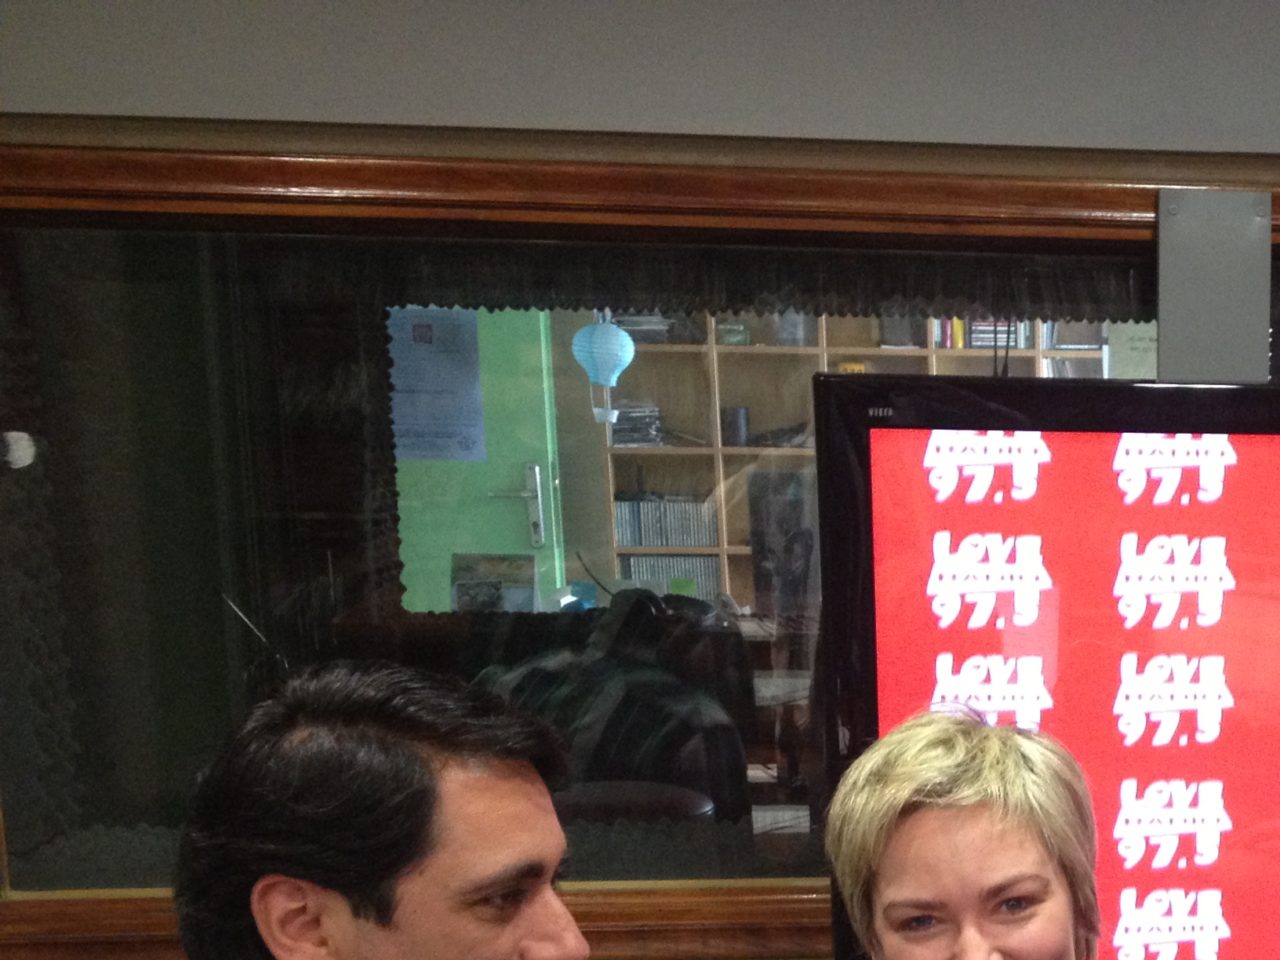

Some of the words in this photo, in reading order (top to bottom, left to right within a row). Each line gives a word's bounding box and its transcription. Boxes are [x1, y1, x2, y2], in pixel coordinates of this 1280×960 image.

[934, 530, 1043, 566] LOVE
[1120, 532, 1227, 568] LOVE
[937, 652, 1044, 687] LOVE
[1120, 652, 1226, 686] LOVE
[1120, 777, 1224, 811] LOVE
[1120, 887, 1223, 920] LOVE
